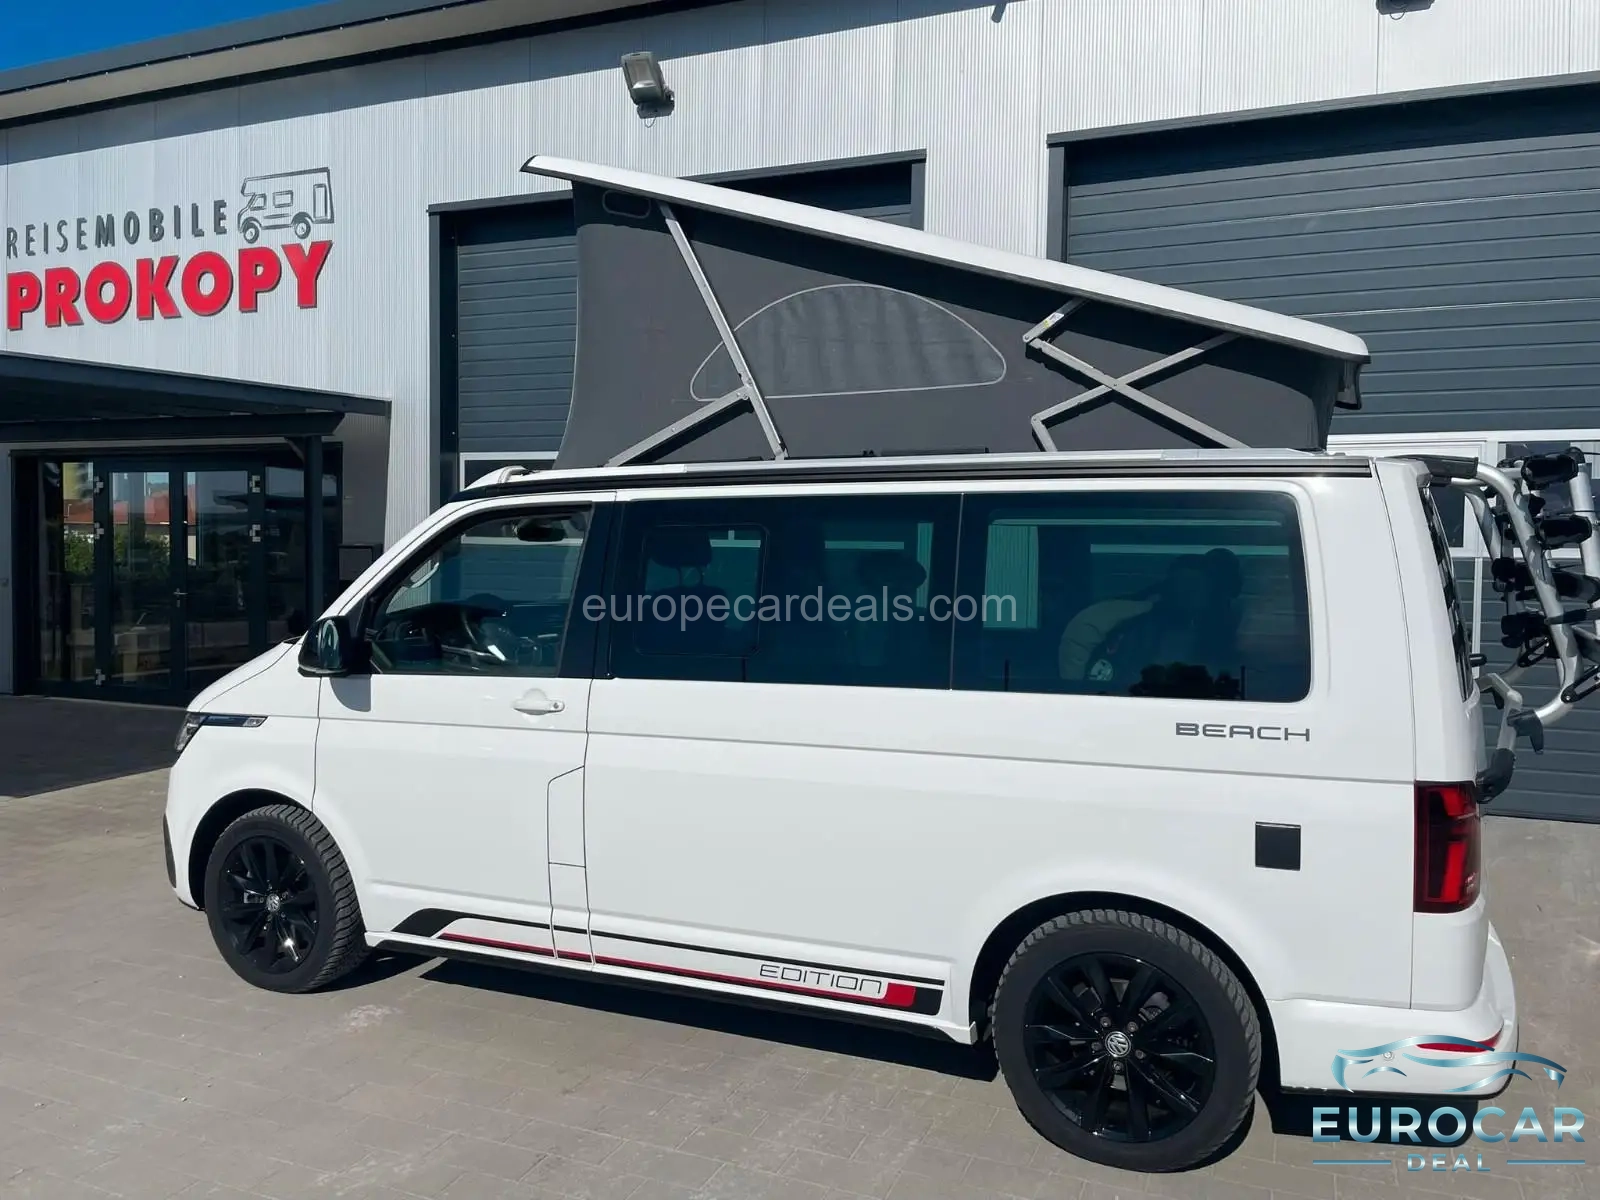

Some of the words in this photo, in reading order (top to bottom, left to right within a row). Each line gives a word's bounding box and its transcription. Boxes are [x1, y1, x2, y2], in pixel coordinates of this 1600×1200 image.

[6, 200, 227, 259] REISEMOBILE
[6, 239, 332, 331] PROKOPY
[1175, 722, 1310, 742] BEACH
[760, 964, 882, 994] EDITION
